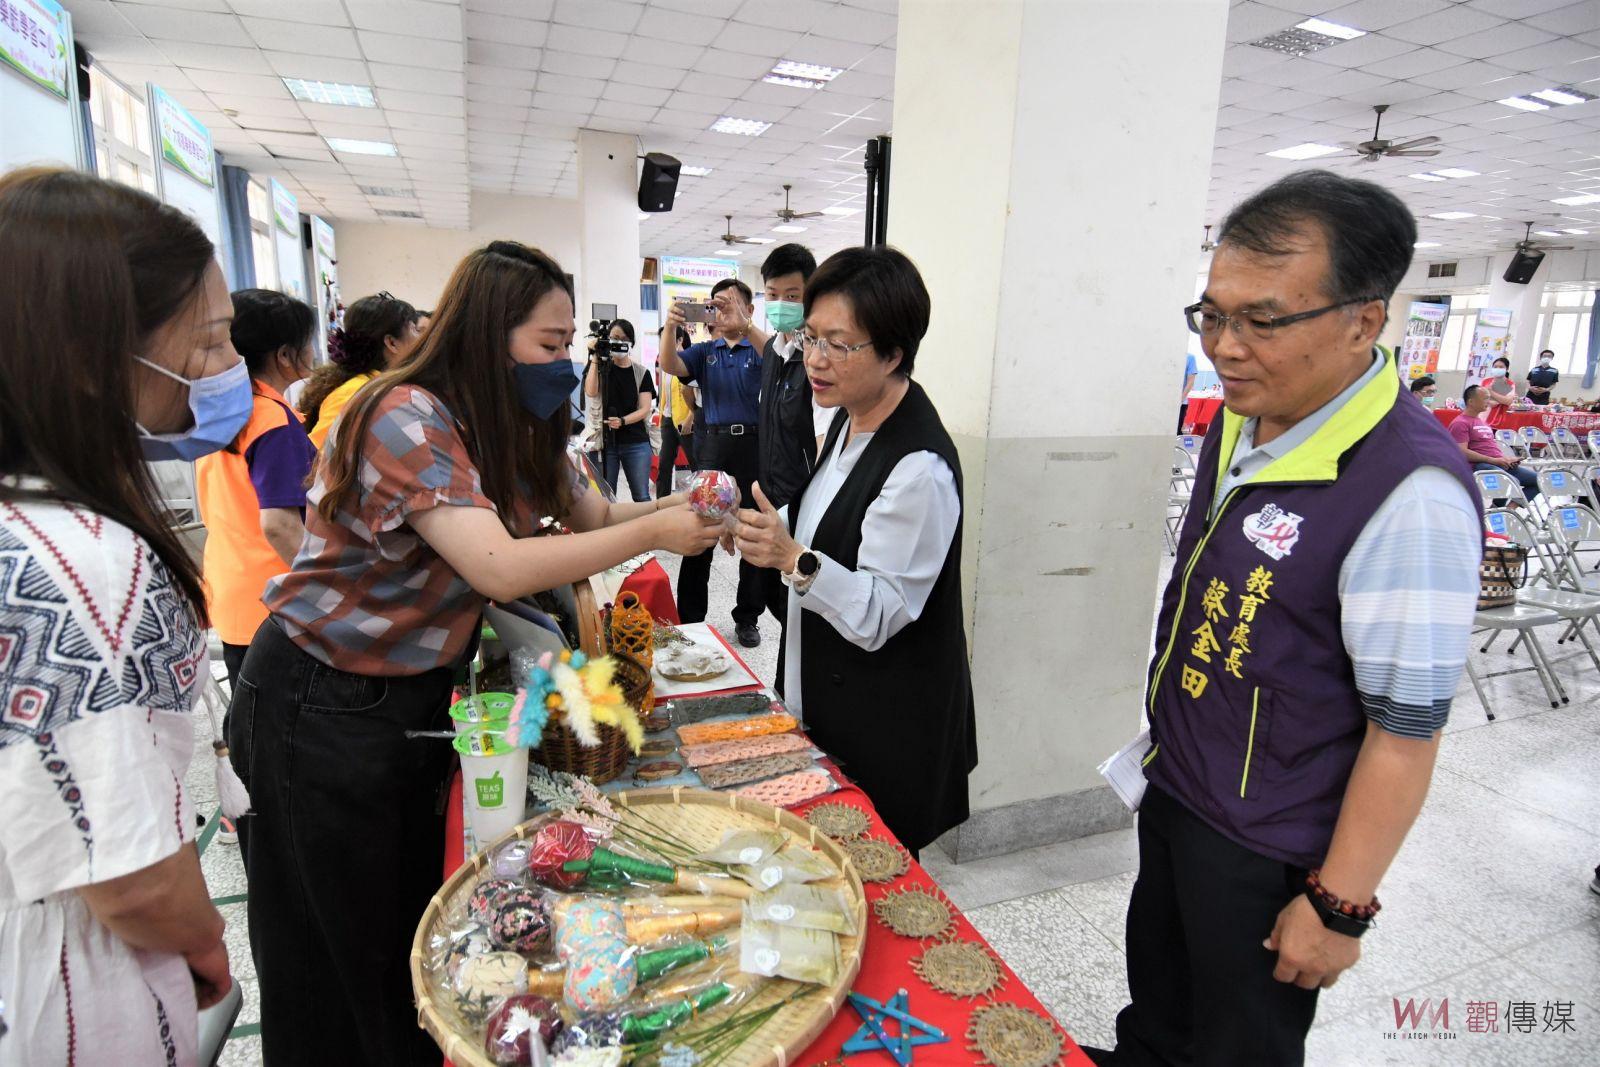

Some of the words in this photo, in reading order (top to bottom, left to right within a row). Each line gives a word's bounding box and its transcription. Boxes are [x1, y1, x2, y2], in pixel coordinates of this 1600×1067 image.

[1181, 576, 1230, 699] 蔡金田
[1224, 564, 1275, 679] 教育處長
[478, 784, 500, 793] TEAS
